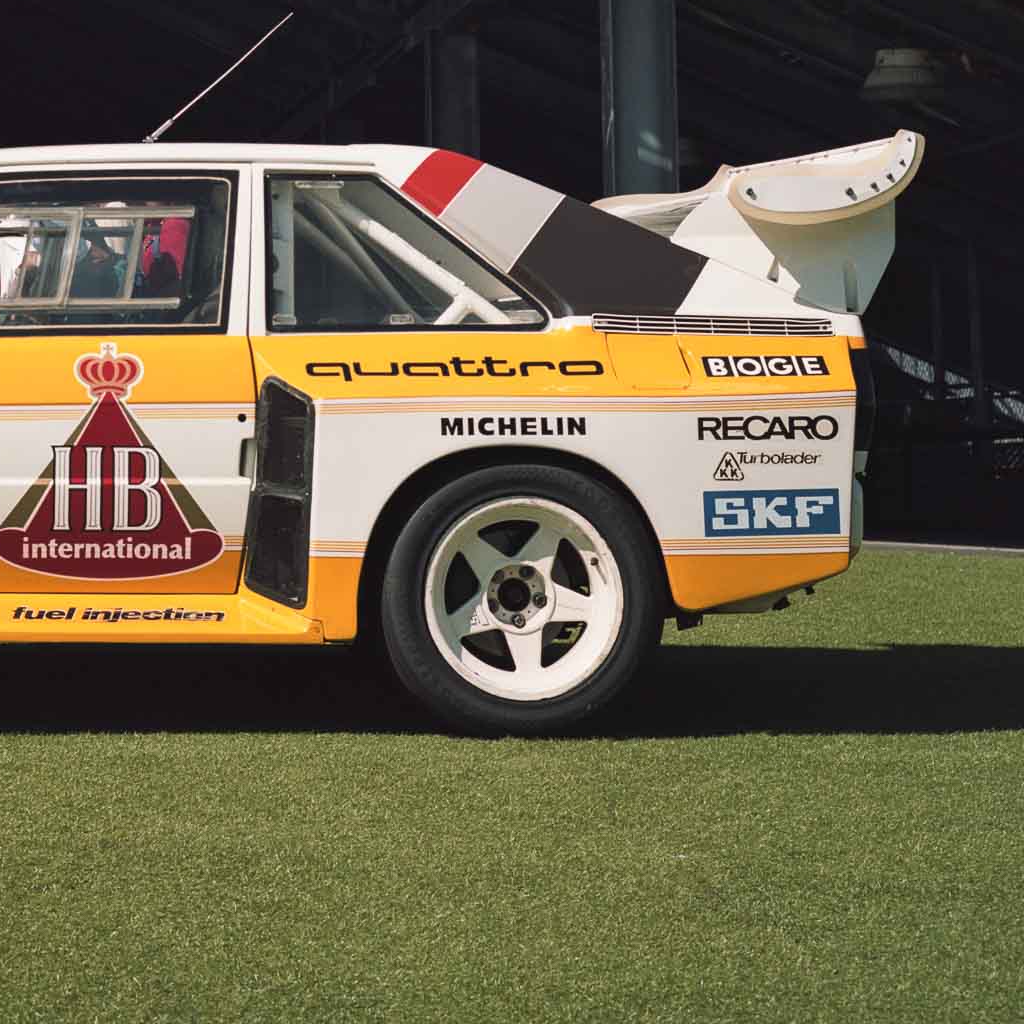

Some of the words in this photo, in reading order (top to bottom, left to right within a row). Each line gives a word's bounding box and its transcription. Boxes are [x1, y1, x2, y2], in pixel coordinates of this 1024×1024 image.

[305, 356, 604, 382] quattro
[707, 357, 823, 376] BOGE
[440, 417, 587, 436] MICHELIN
[697, 415, 839, 440] RECARO
[51, 445, 164, 532] HB
[712, 496, 834, 530] SKF
[22, 537, 192, 560] international
[12, 607, 77, 621] fuel
[81, 607, 225, 622] injection
